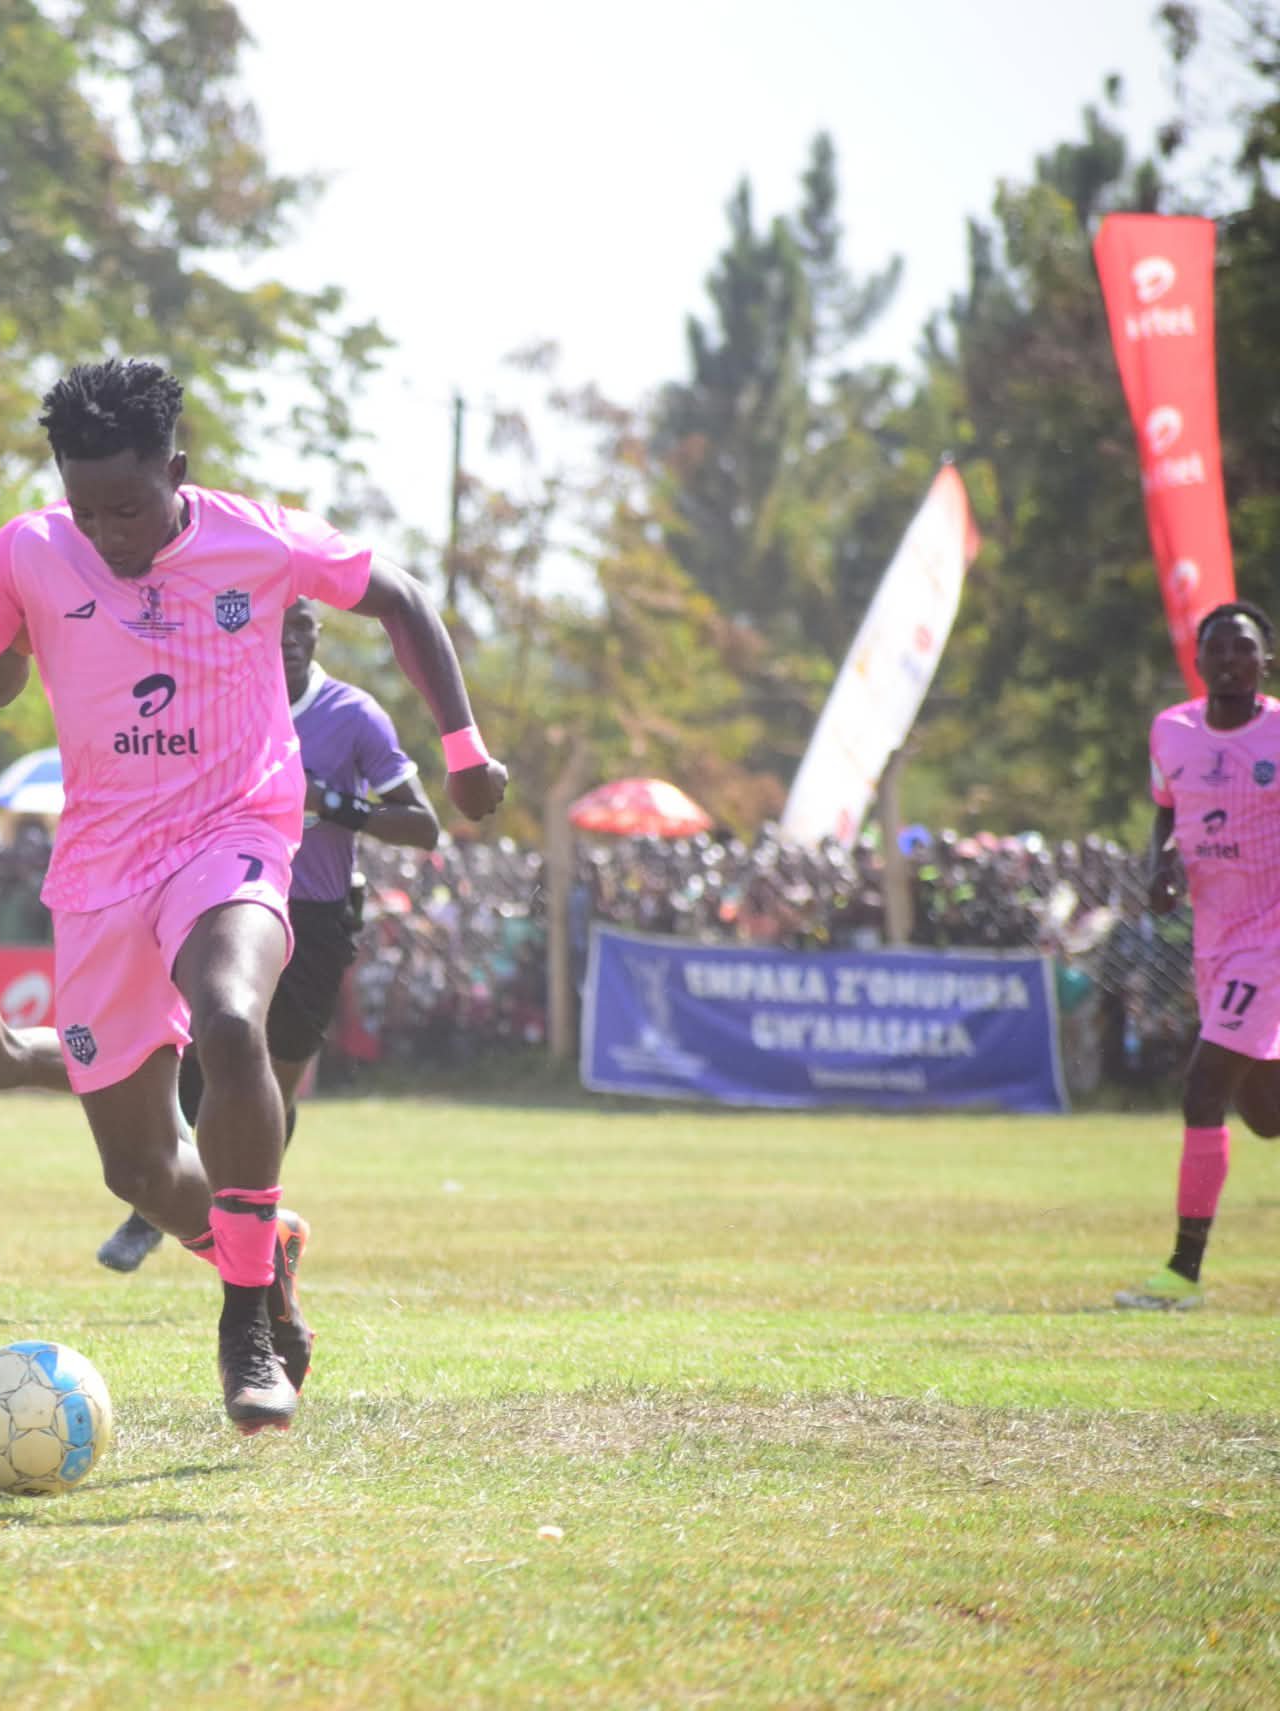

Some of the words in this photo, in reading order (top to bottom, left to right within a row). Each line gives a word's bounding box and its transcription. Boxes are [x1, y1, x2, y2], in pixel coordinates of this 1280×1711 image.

[113, 726, 198, 755] airtel
[237, 853, 263, 882] 7
[1220, 979, 1258, 1016] 17
